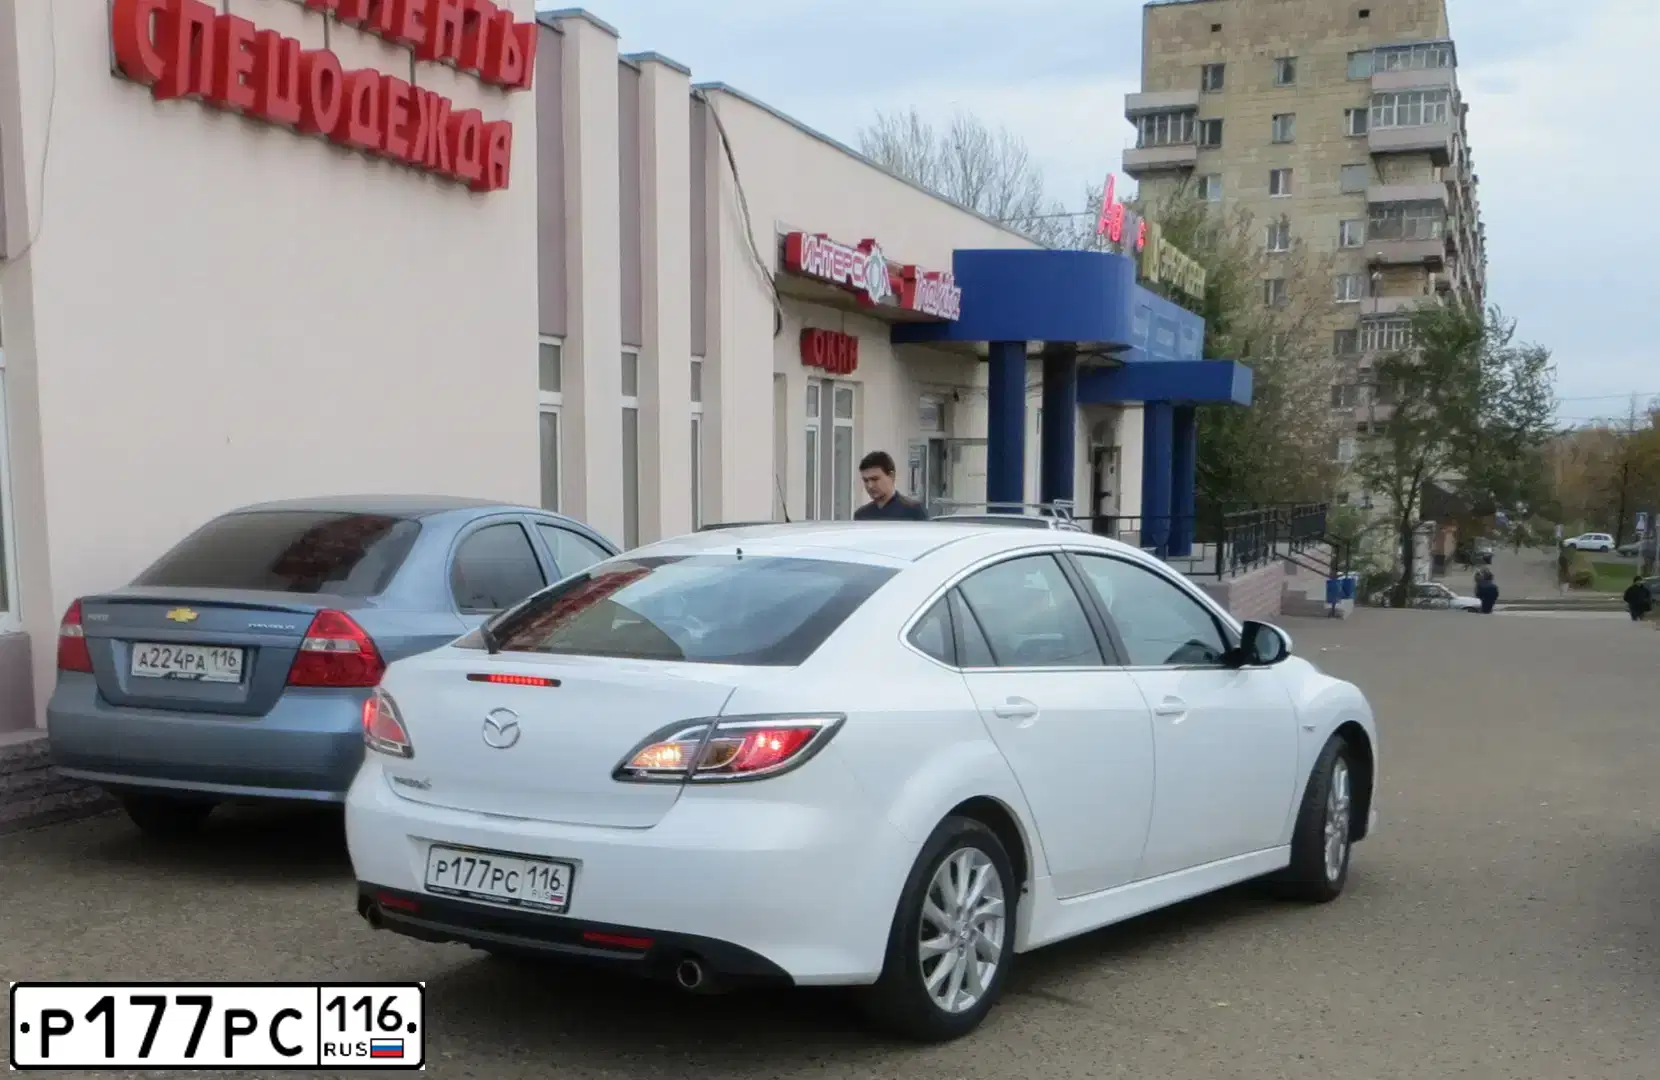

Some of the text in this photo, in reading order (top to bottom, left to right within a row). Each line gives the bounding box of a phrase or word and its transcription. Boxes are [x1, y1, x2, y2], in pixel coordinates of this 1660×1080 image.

[113, 0, 513, 190] СПЕЦОДЕЖДА
[139, 647, 237, 671] А224РА 116
[435, 856, 561, 893] Р177РС 116
